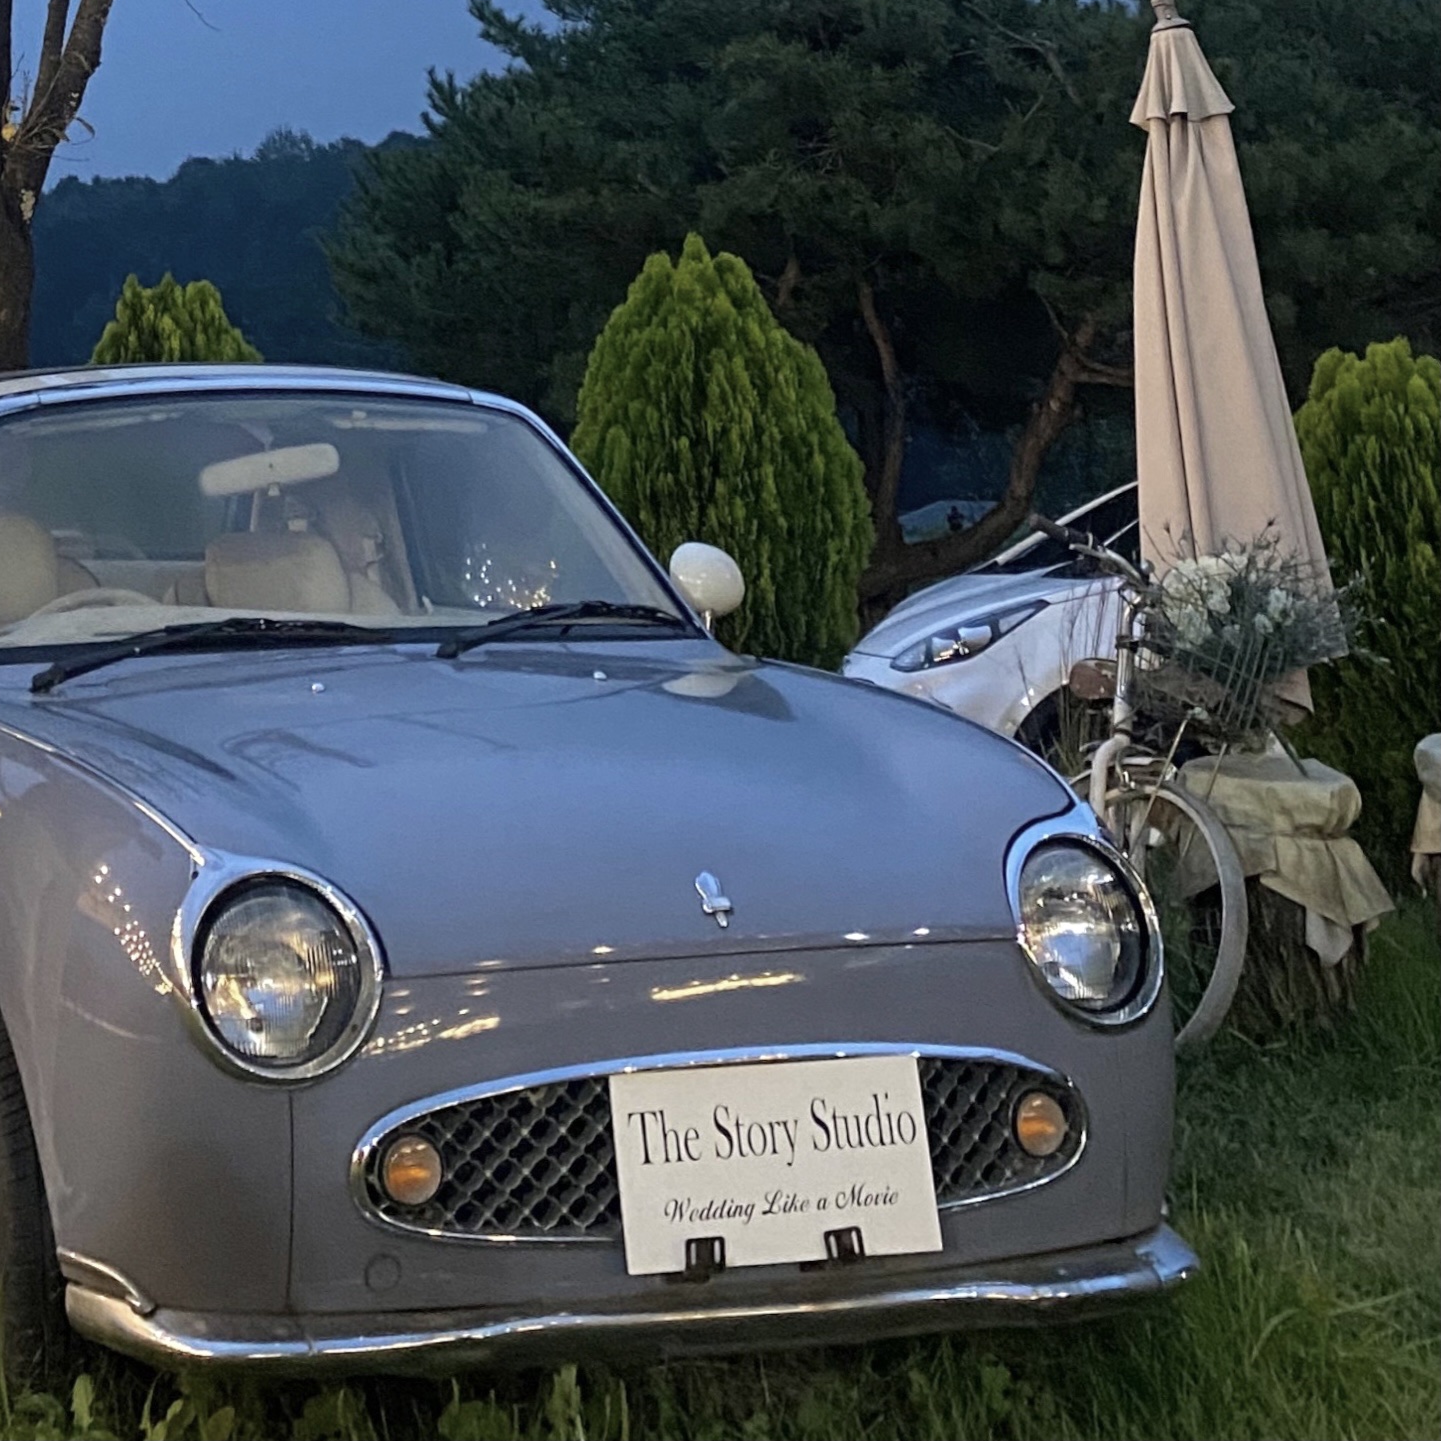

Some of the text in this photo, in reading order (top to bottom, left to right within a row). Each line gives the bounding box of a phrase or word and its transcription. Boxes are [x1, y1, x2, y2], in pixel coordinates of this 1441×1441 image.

[627, 1092, 917, 1167] The Story Studio
[663, 1183, 899, 1225] Wedding Like a Movie
